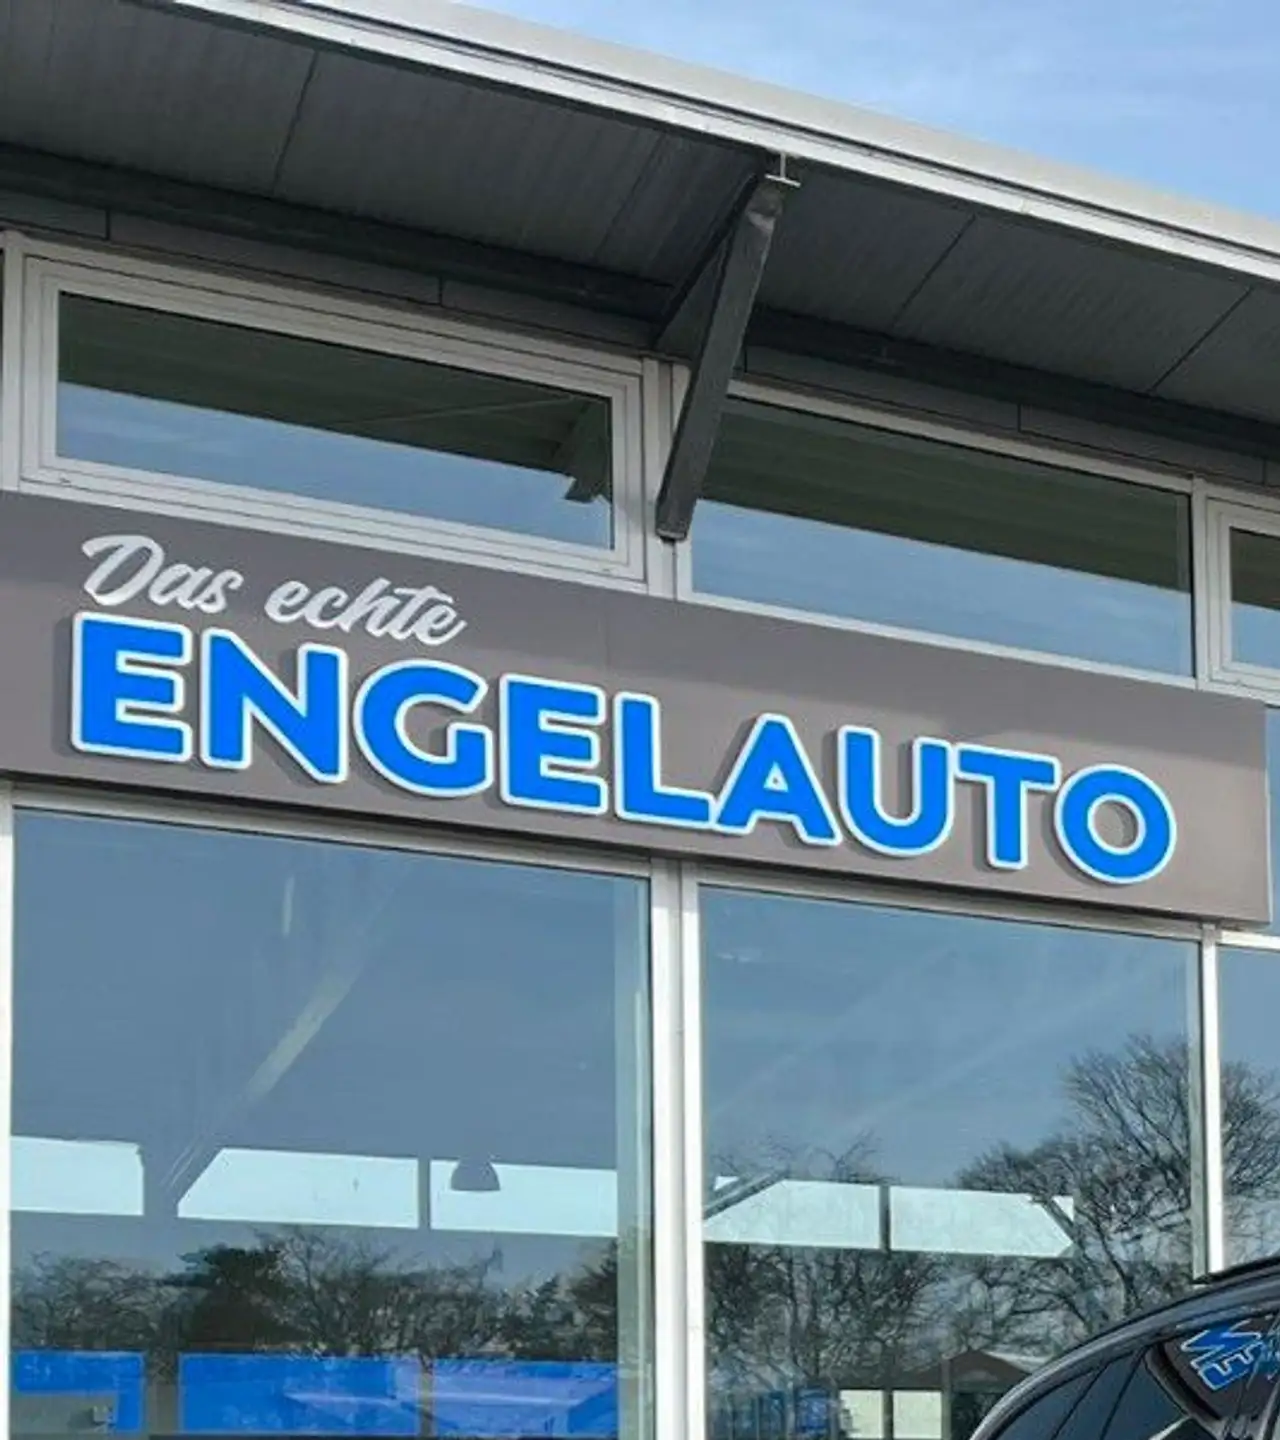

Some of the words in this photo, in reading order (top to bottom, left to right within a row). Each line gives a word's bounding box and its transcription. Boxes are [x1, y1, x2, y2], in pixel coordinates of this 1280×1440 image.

[81, 534, 244, 614] Das
[264, 578, 468, 647] echte
[69, 611, 1178, 885] ENGELAUTO
